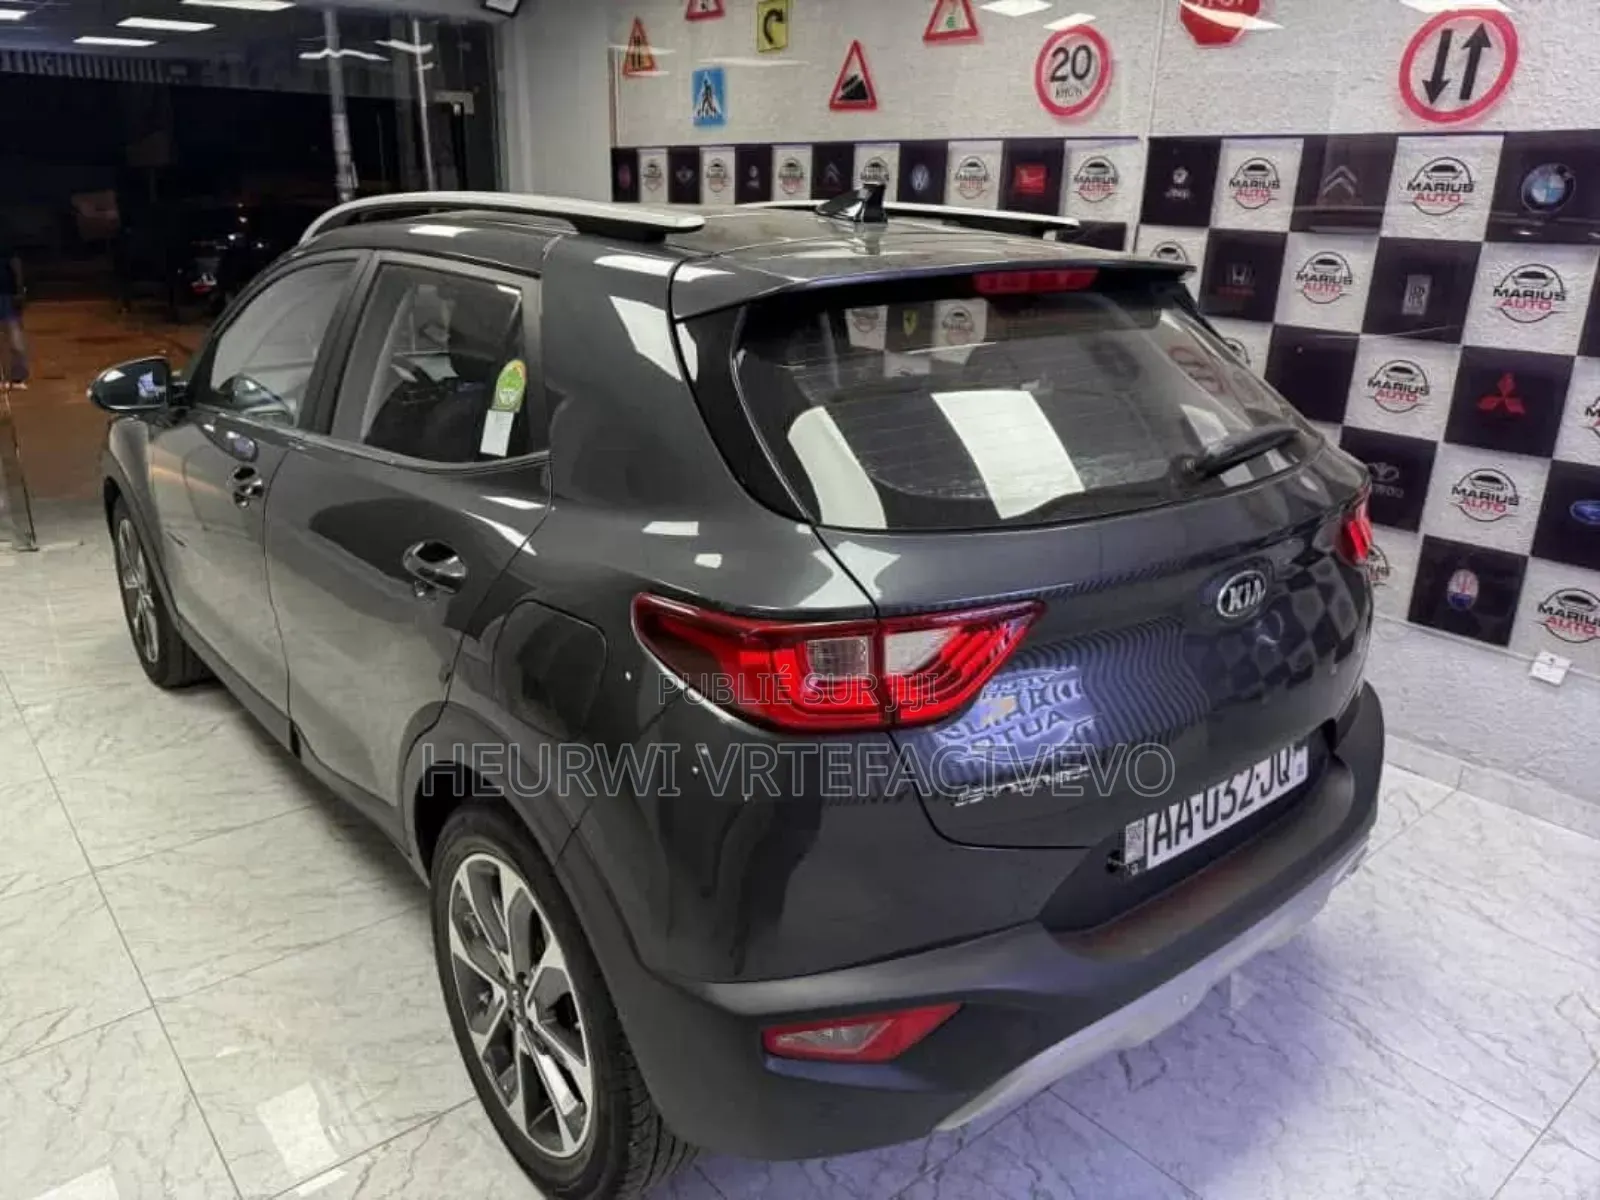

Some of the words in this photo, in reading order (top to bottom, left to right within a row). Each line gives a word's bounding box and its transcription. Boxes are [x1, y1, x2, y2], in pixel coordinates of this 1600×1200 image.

[1050, 44, 1092, 82] 20
[1229, 178, 1281, 189] MARIUS
[1406, 181, 1475, 193] MARIUS
[1235, 188, 1272, 199] AUTO
[1413, 192, 1462, 203] AUTO
[1296, 272, 1353, 286] MARIUS
[1303, 282, 1343, 293] AUTO
[1493, 286, 1567, 301] MARIUS
[1499, 299, 1553, 310] AUTO
[1367, 378, 1431, 396] MARIUS
[1375, 388, 1419, 402] AUTO
[1451, 486, 1520, 506] MARIUS
[1460, 499, 1507, 513] AUTO
[1228, 578, 1265, 612] KIA
[1537, 602, 1600, 627] MARIU
[1546, 615, 1597, 634] AUTO
